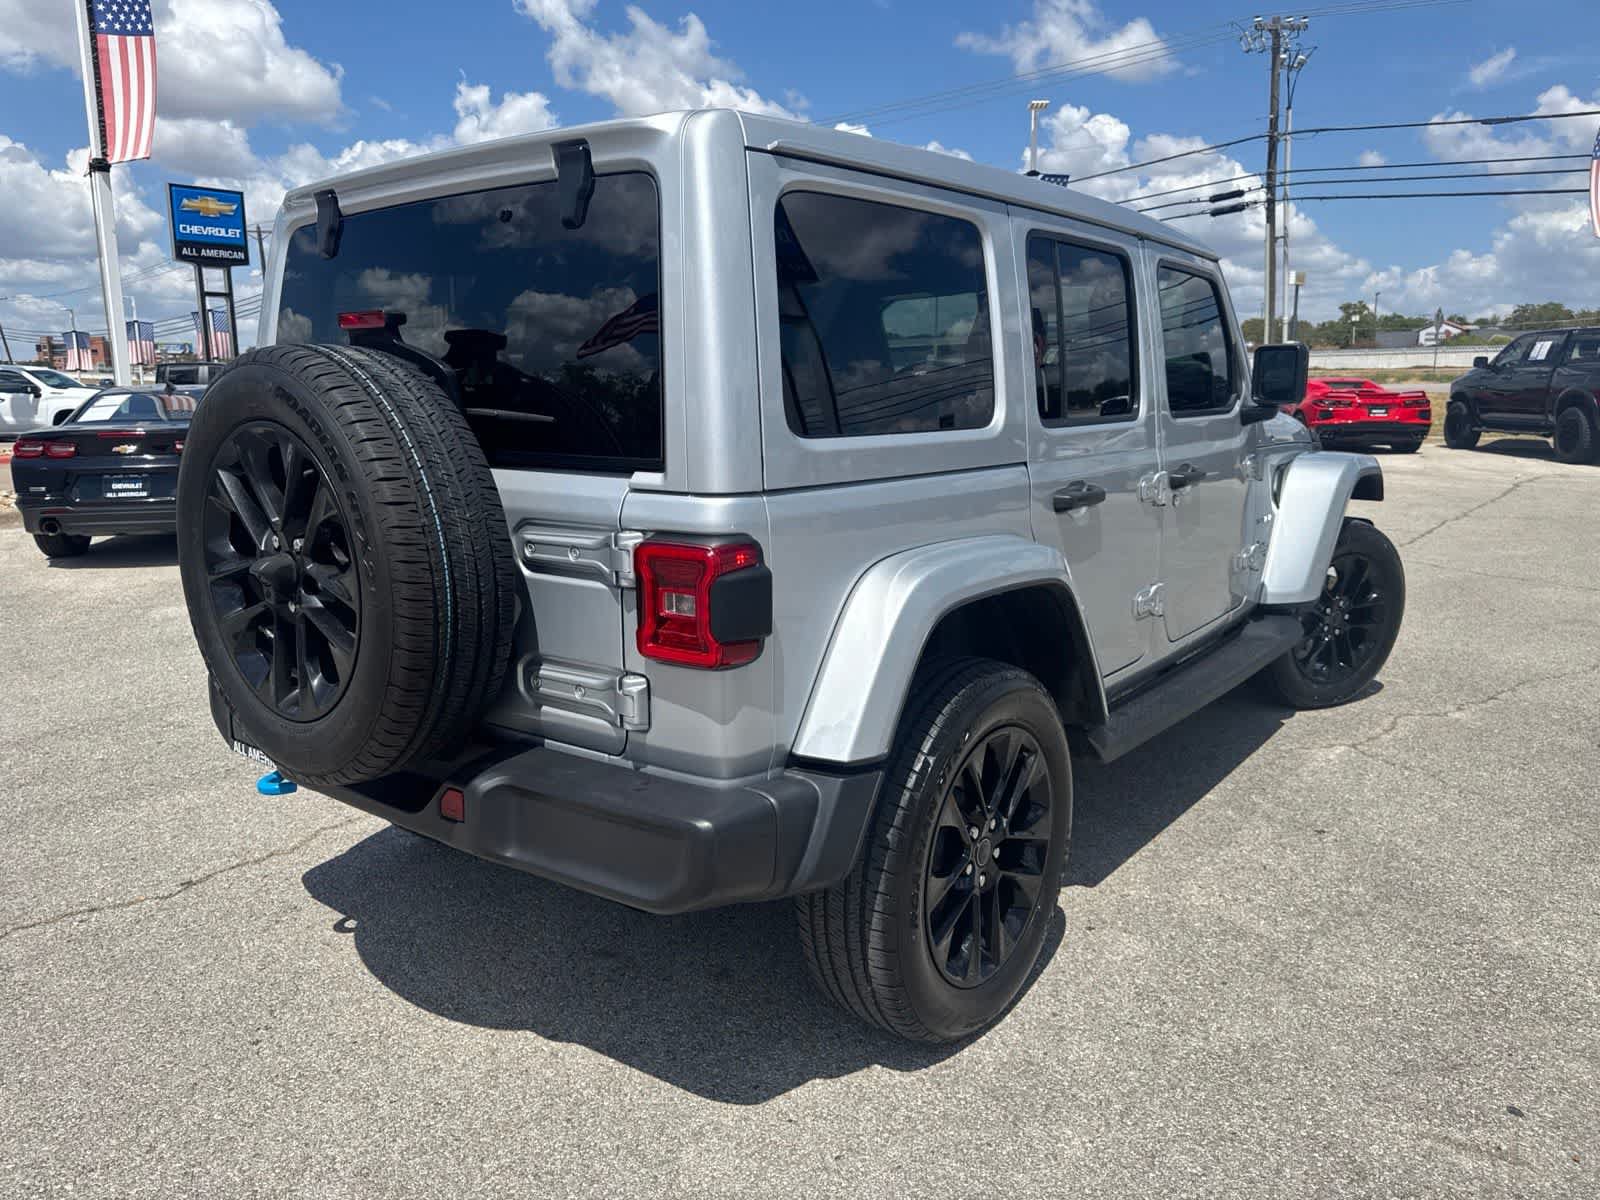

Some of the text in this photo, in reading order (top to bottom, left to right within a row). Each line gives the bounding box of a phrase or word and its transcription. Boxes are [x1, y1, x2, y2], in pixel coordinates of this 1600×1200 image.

[179, 224, 241, 238] CHEVROLET
[182, 247, 245, 259] ALL AMERICAN
[233, 740, 247, 756] ALL
